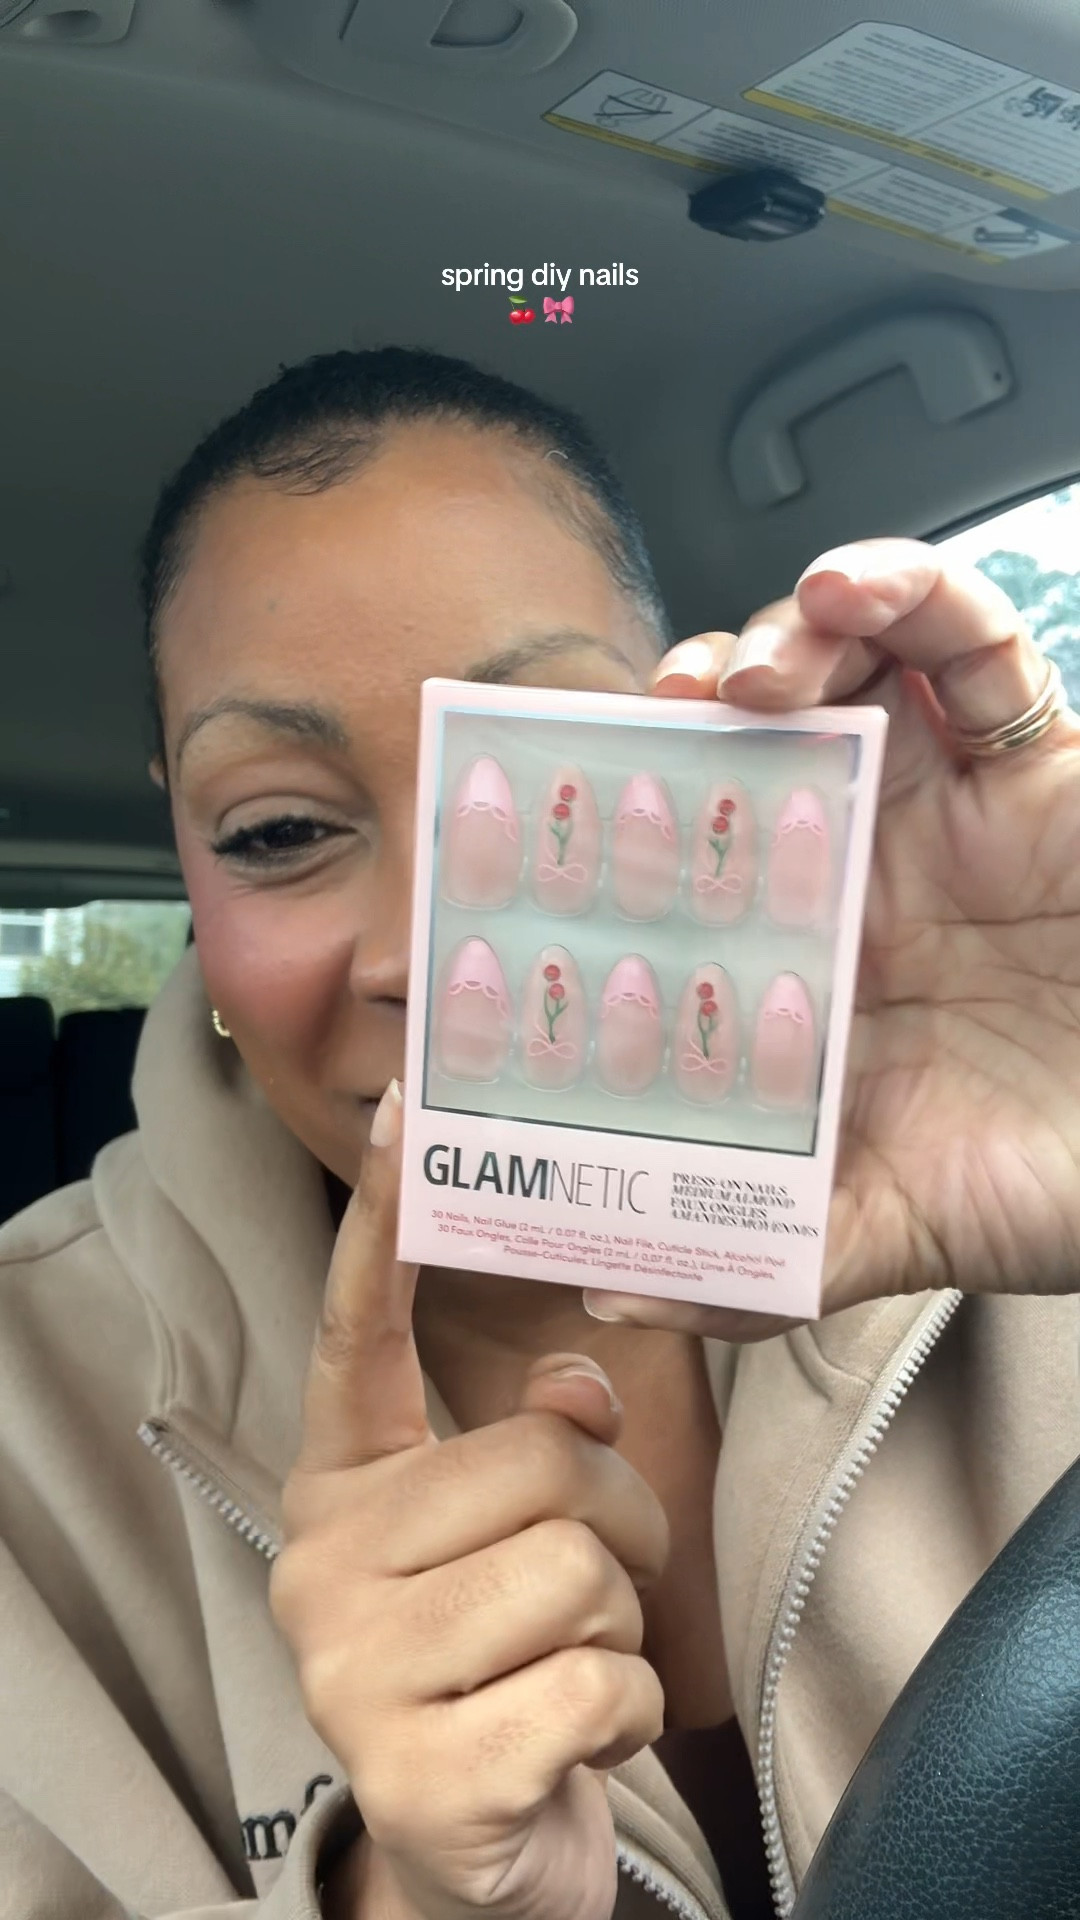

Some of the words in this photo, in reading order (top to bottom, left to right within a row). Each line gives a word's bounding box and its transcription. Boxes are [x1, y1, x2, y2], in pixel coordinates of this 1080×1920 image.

[422, 1143, 650, 1215] GLAMNETIC
[672, 1172, 741, 1190] PRESS-ON
[742, 1180, 788, 1196] NAILS
[709, 1202, 768, 1218] ONGLES
[431, 1210, 444, 1219] 30
[446, 1212, 470, 1223] Nails,
[474, 1216, 492, 1226] Nail
[494, 1218, 517, 1230] Glue
[614, 1235, 634, 1246] Nail
[658, 1241, 693, 1255] Cuticle
[723, 1251, 762, 1264] Alcohol
[437, 1224, 450, 1233] 30
[451, 1226, 474, 1236] Faux
[476, 1229, 511, 1242] Ongles,
[514, 1235, 539, 1246] Colle
[541, 1238, 565, 1249] Pour
[567, 1242, 602, 1255] Ongles
[700, 1261, 725, 1273] Lime
[591, 1258, 632, 1272] Lingette
